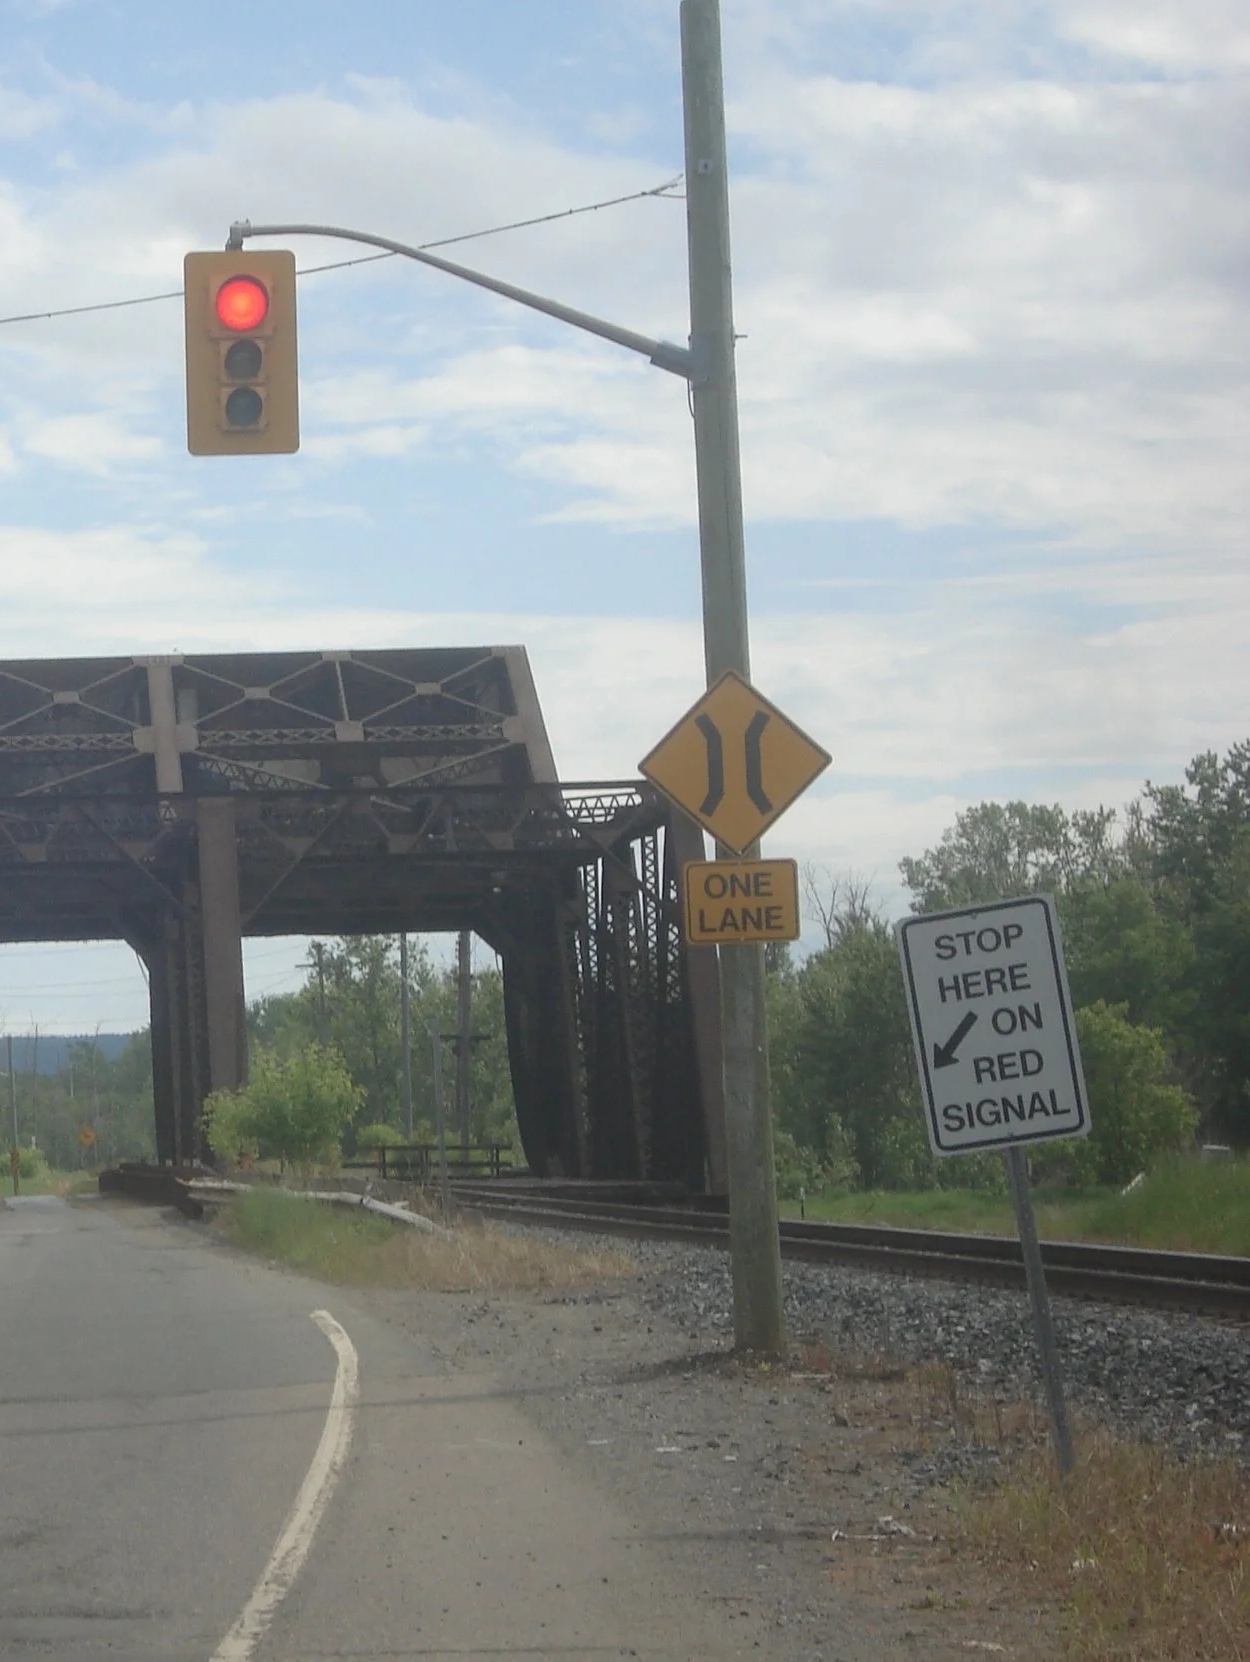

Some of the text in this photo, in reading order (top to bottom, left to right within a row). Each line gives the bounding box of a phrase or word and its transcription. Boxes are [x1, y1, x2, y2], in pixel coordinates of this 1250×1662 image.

[704, 872, 773, 899] ONE
[698, 905, 784, 933] LANE
[934, 923, 1023, 960] STOP
[938, 963, 1031, 1002] HERE
[991, 1002, 1043, 1035] ON
[973, 1049, 1044, 1084] RED
[942, 1088, 1071, 1132] SIGNAL
